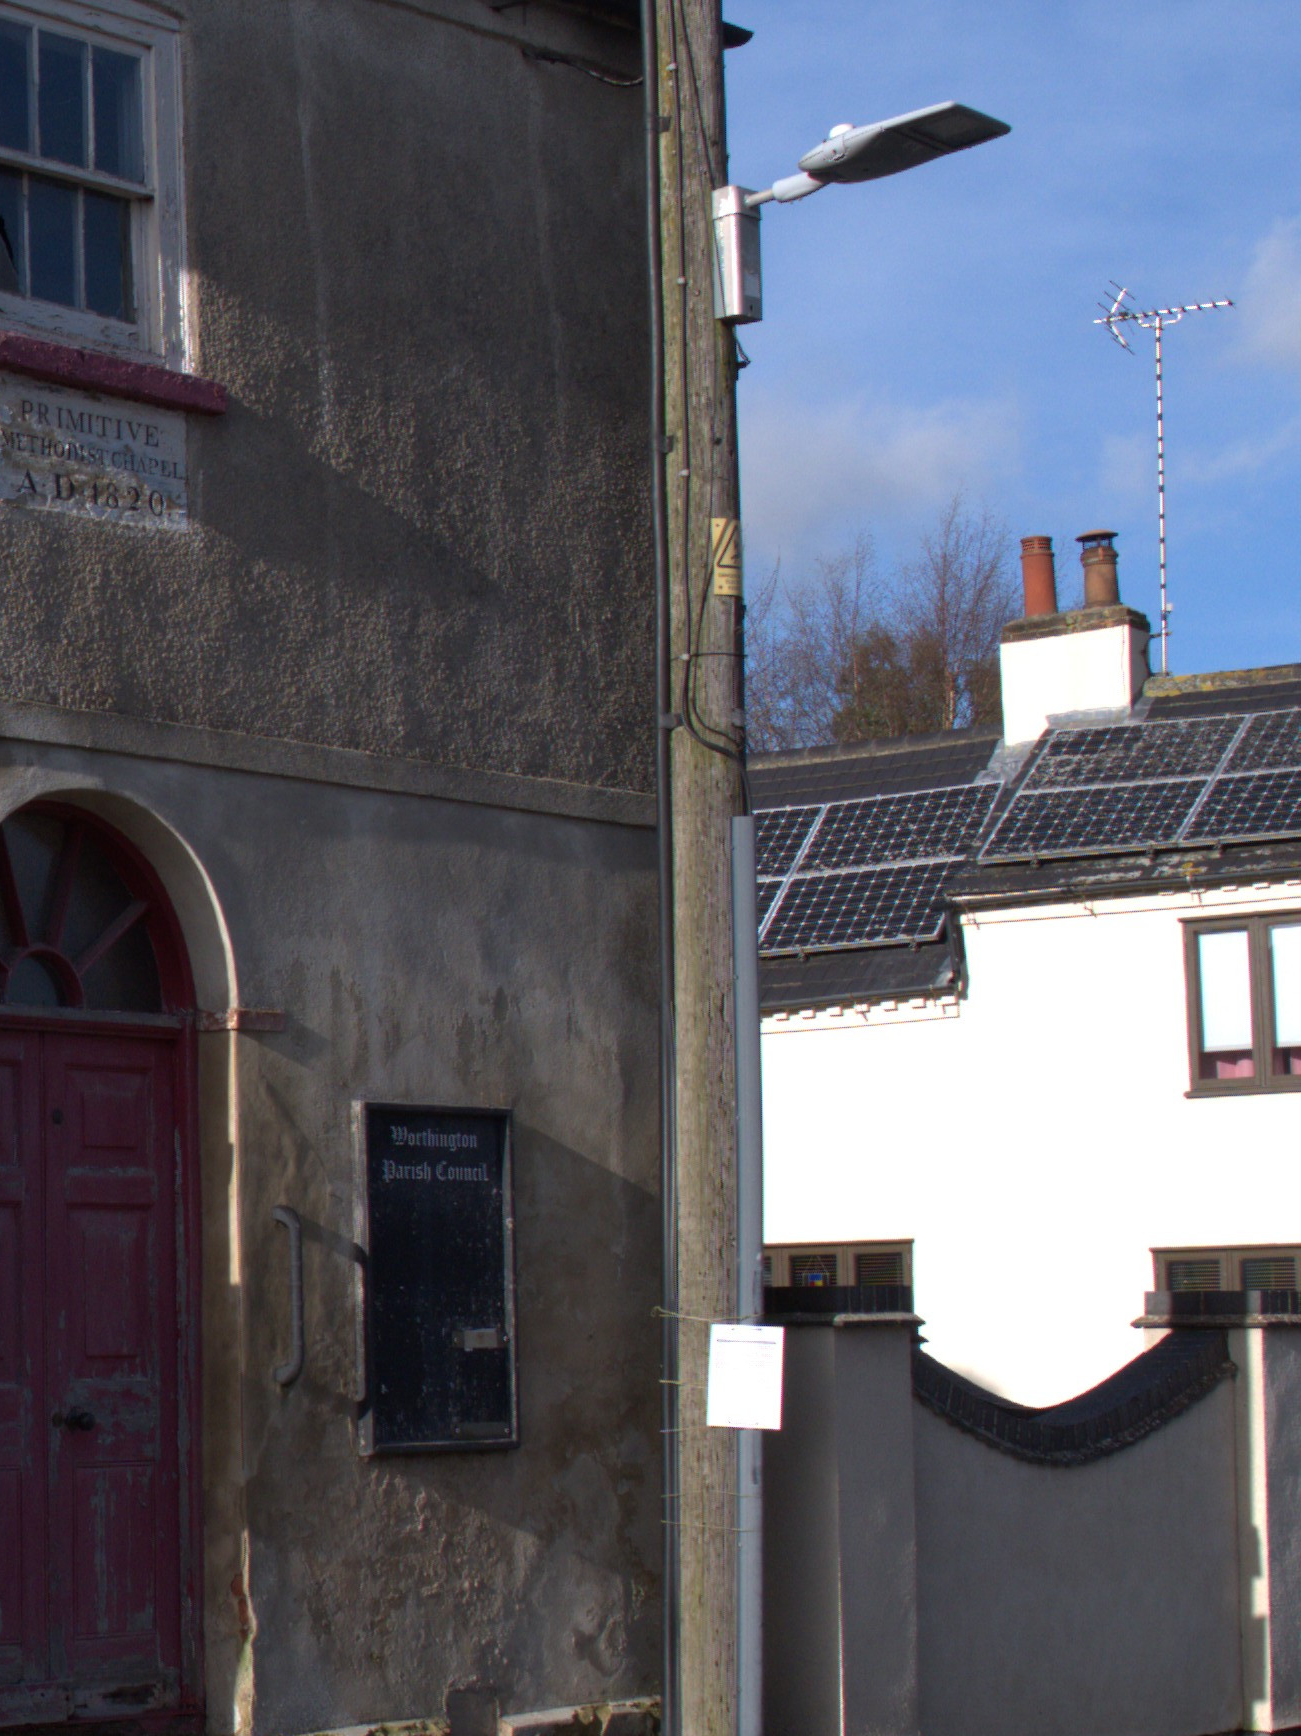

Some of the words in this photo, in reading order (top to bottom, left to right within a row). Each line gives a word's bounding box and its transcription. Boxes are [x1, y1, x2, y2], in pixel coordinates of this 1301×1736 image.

[20, 399, 159, 448] PRIMITIVE
[0, 428, 108, 466] METHODIST
[111, 450, 185, 481] CHAPEL
[390, 1125, 478, 1152] Worthington
[382, 1158, 431, 1184] Parish
[435, 1160, 490, 1182] Council
